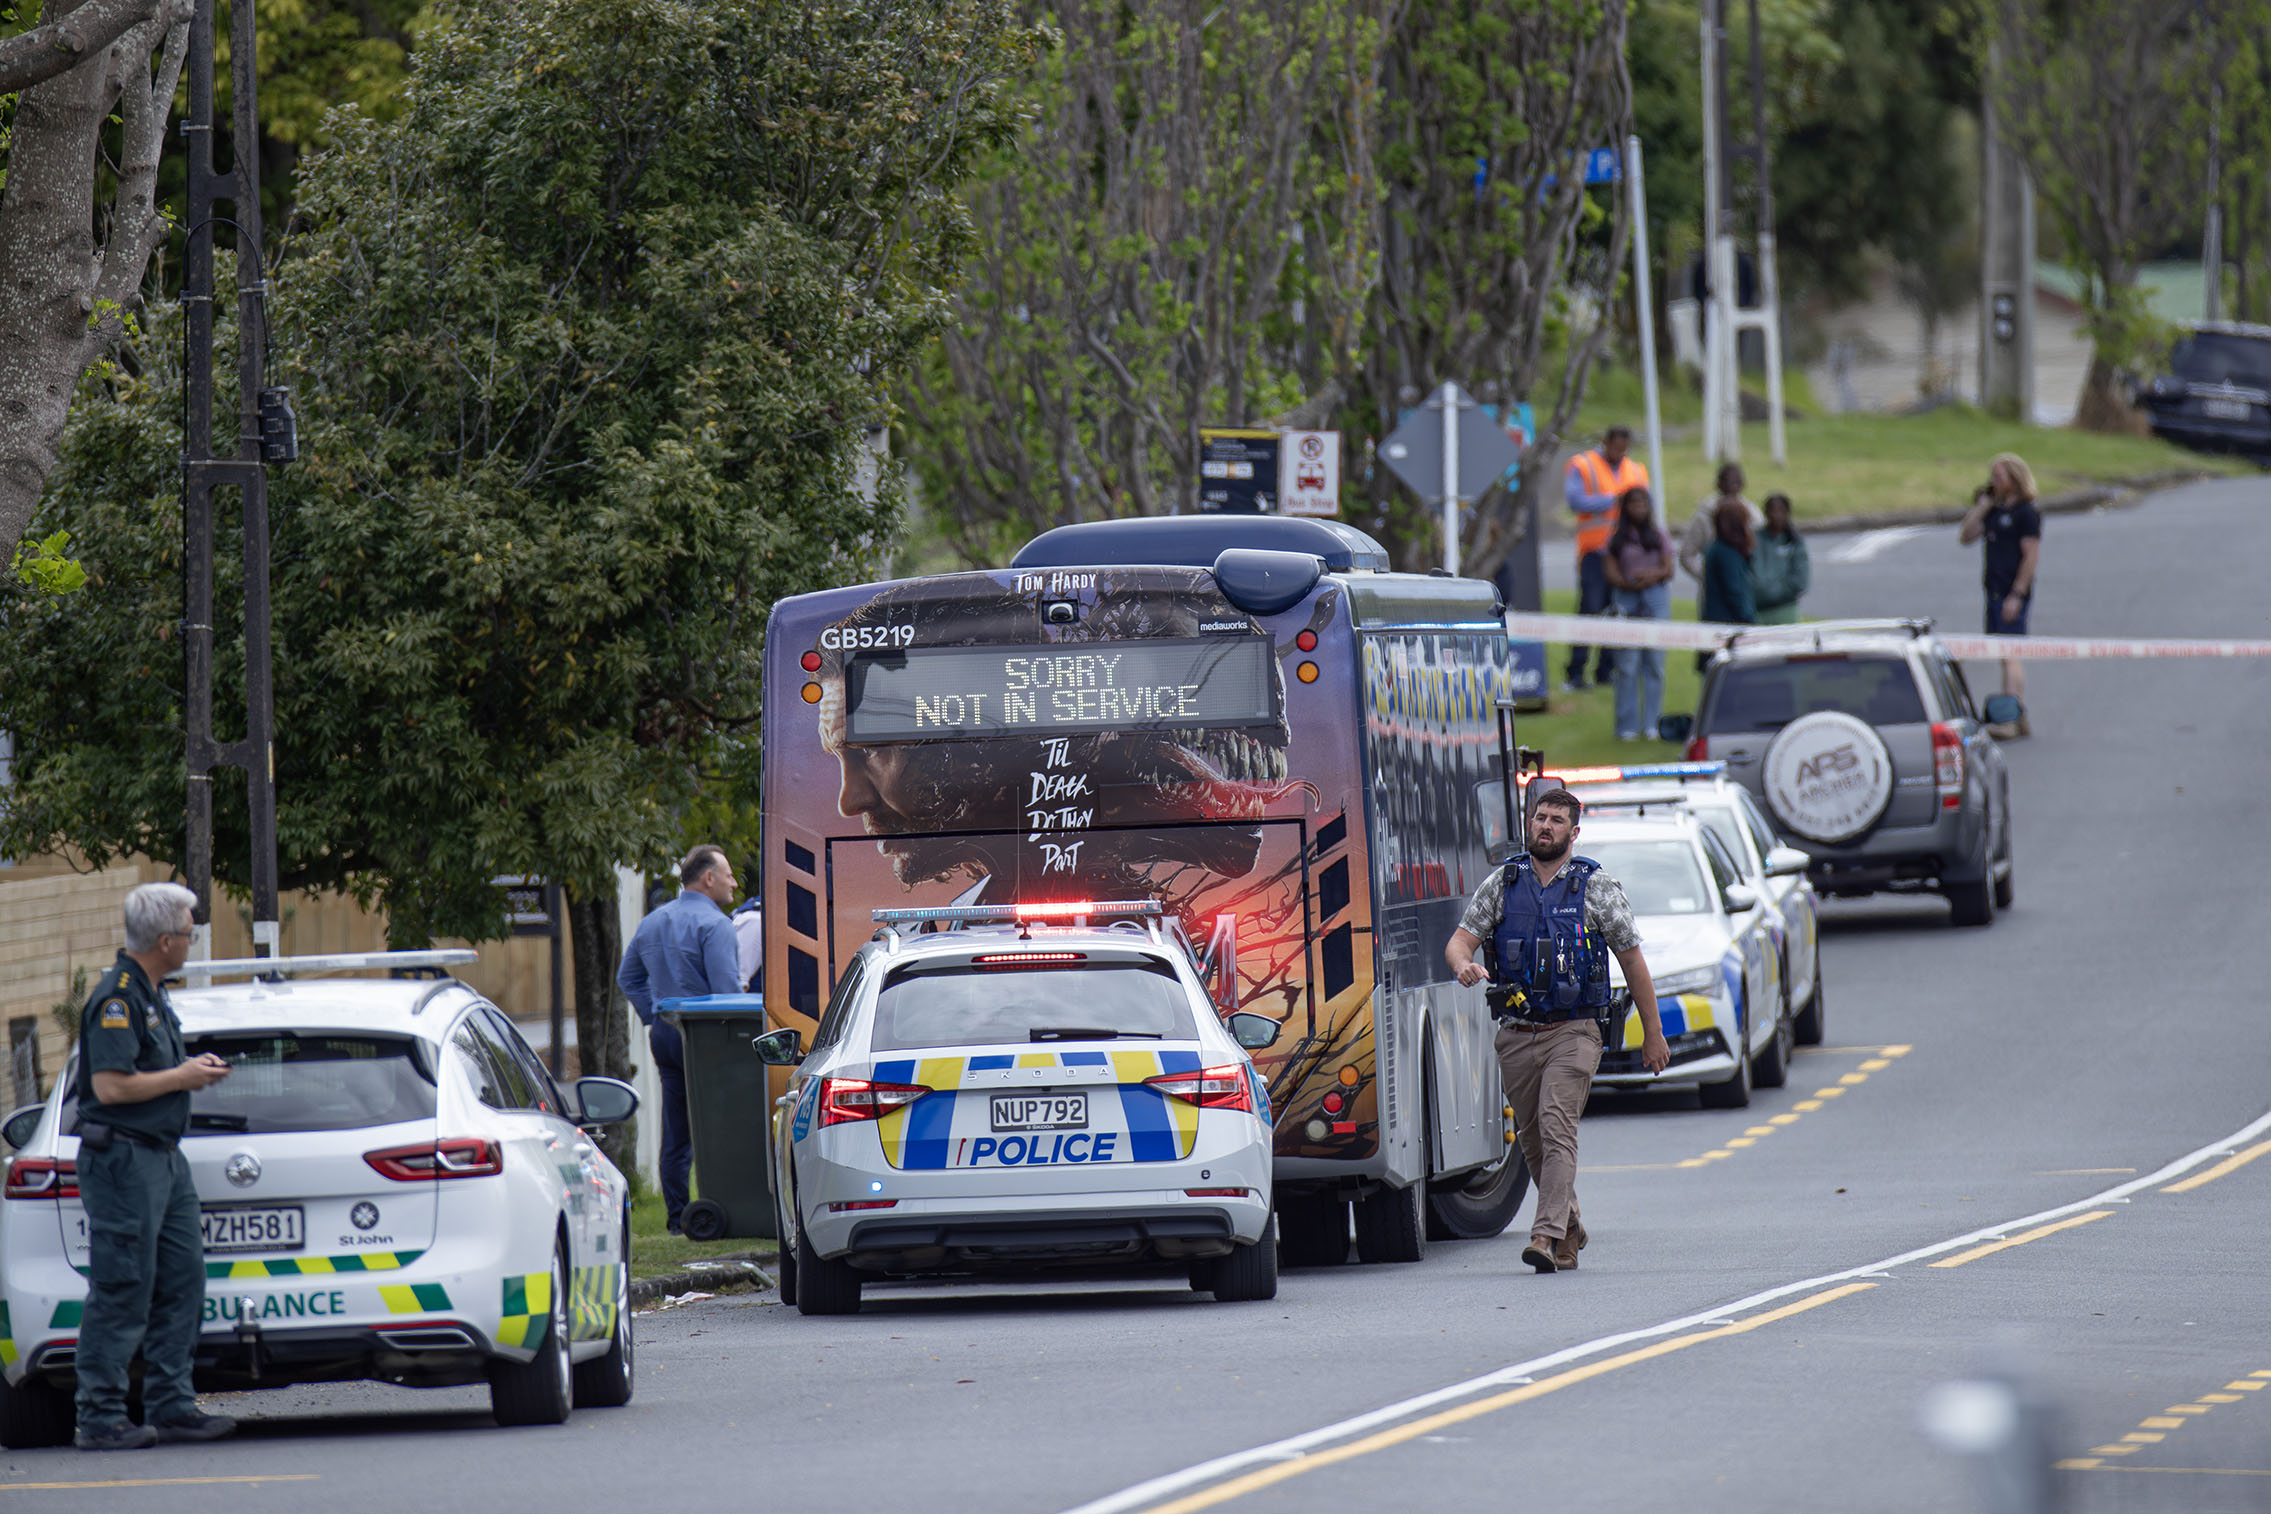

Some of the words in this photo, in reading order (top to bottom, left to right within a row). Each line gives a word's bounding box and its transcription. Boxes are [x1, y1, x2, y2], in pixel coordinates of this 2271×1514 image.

[1013, 573, 1043, 594] TOM
[1052, 571, 1097, 593] HARDY
[821, 624, 915, 651] GB5219
[1200, 620, 1248, 631] mediaworks
[1004, 653, 1123, 691] SORRY
[916, 693, 988, 728] NOT
[1004, 690, 1037, 724] IN
[1052, 685, 1200, 722] SERVICE
[995, 1099, 1083, 1124] NUP792
[969, 1132, 1118, 1167] POLICE
[339, 1235, 354, 1247] St
[357, 1233, 394, 1246] John
